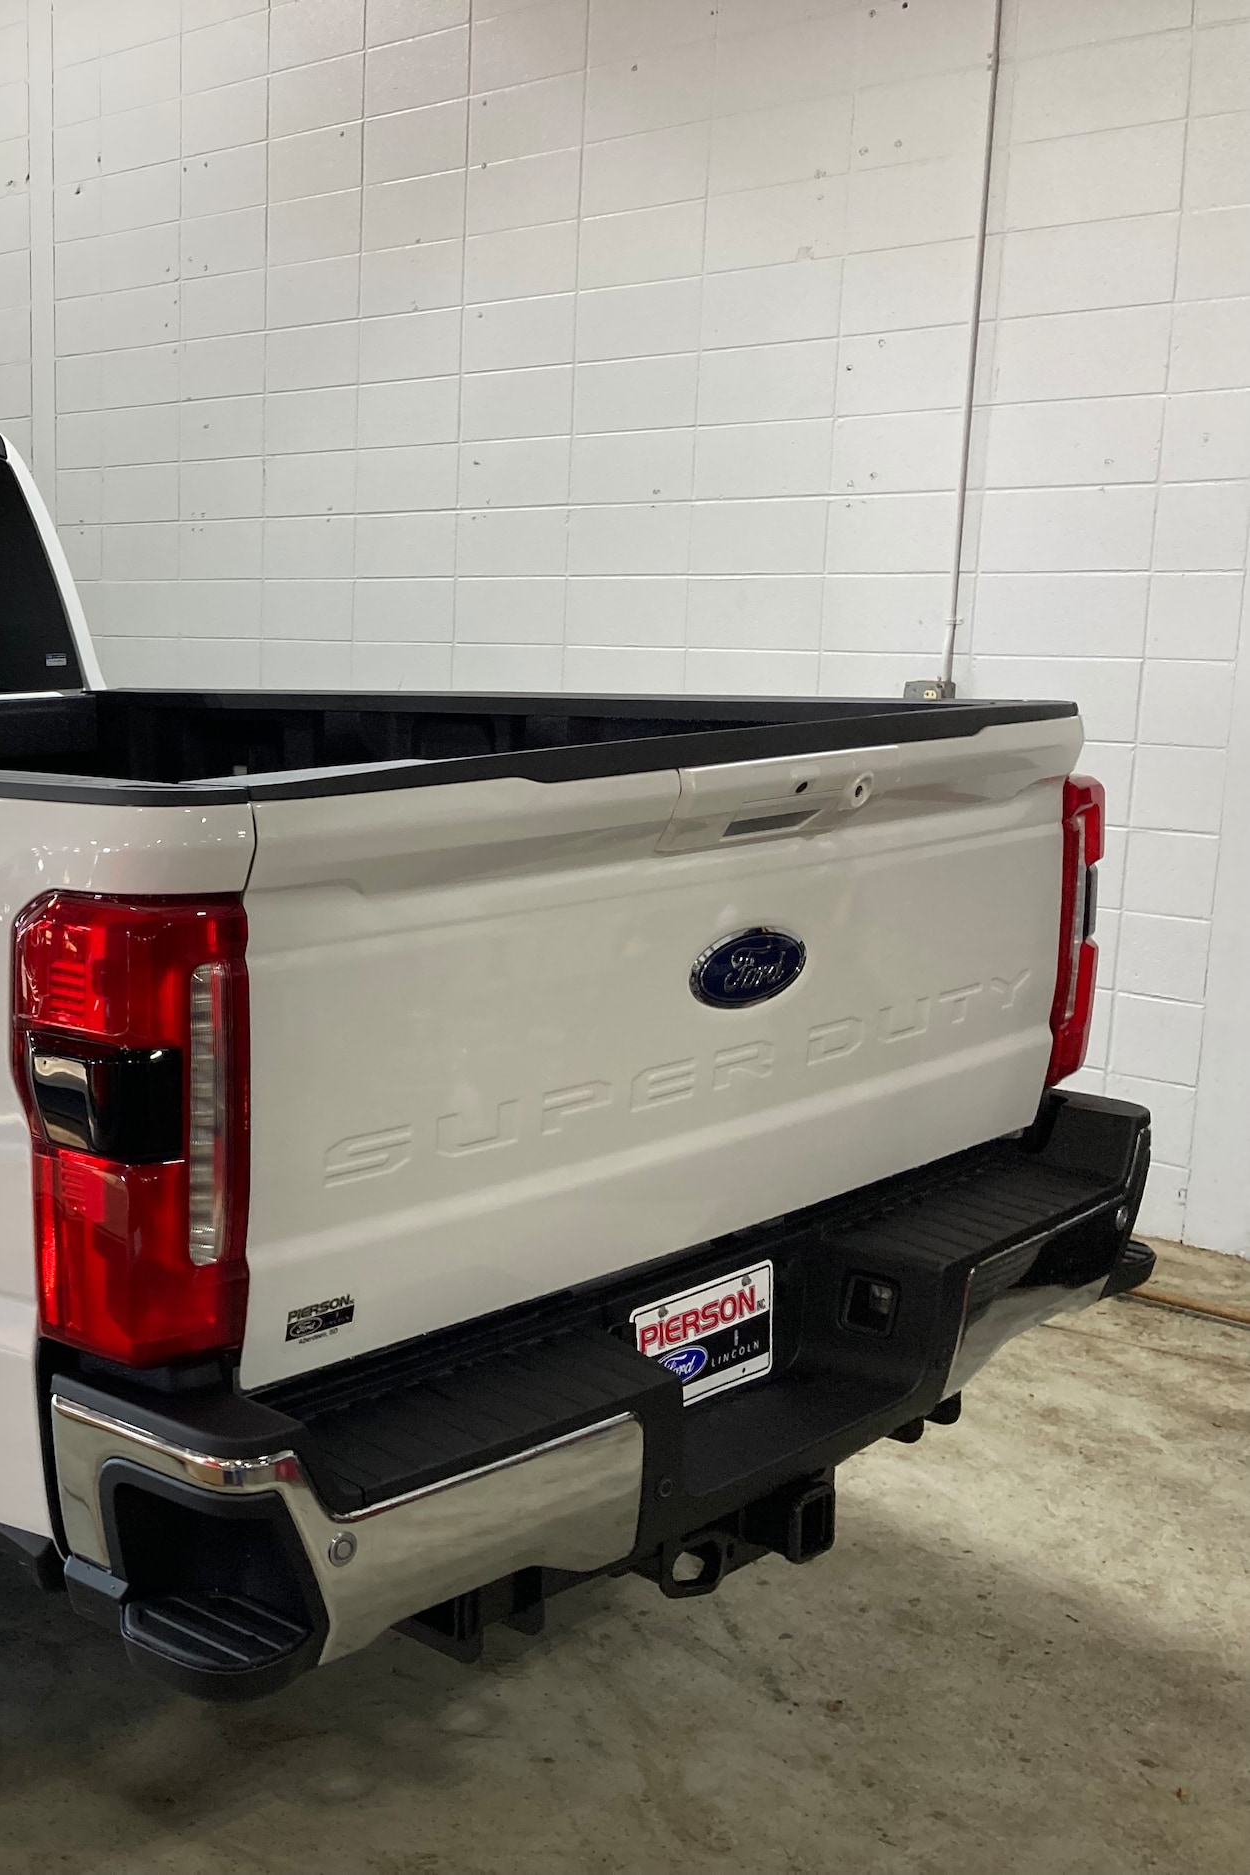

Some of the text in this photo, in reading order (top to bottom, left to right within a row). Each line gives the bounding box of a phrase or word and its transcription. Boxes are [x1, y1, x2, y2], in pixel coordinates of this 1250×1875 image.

[724, 945, 786, 993] Ford
[324, 968, 1031, 1188] SUPER DUTY
[288, 1294, 350, 1322] PIERSON
[639, 1285, 756, 1354] PIERSON
[711, 1340, 760, 1368] LINCOLN
